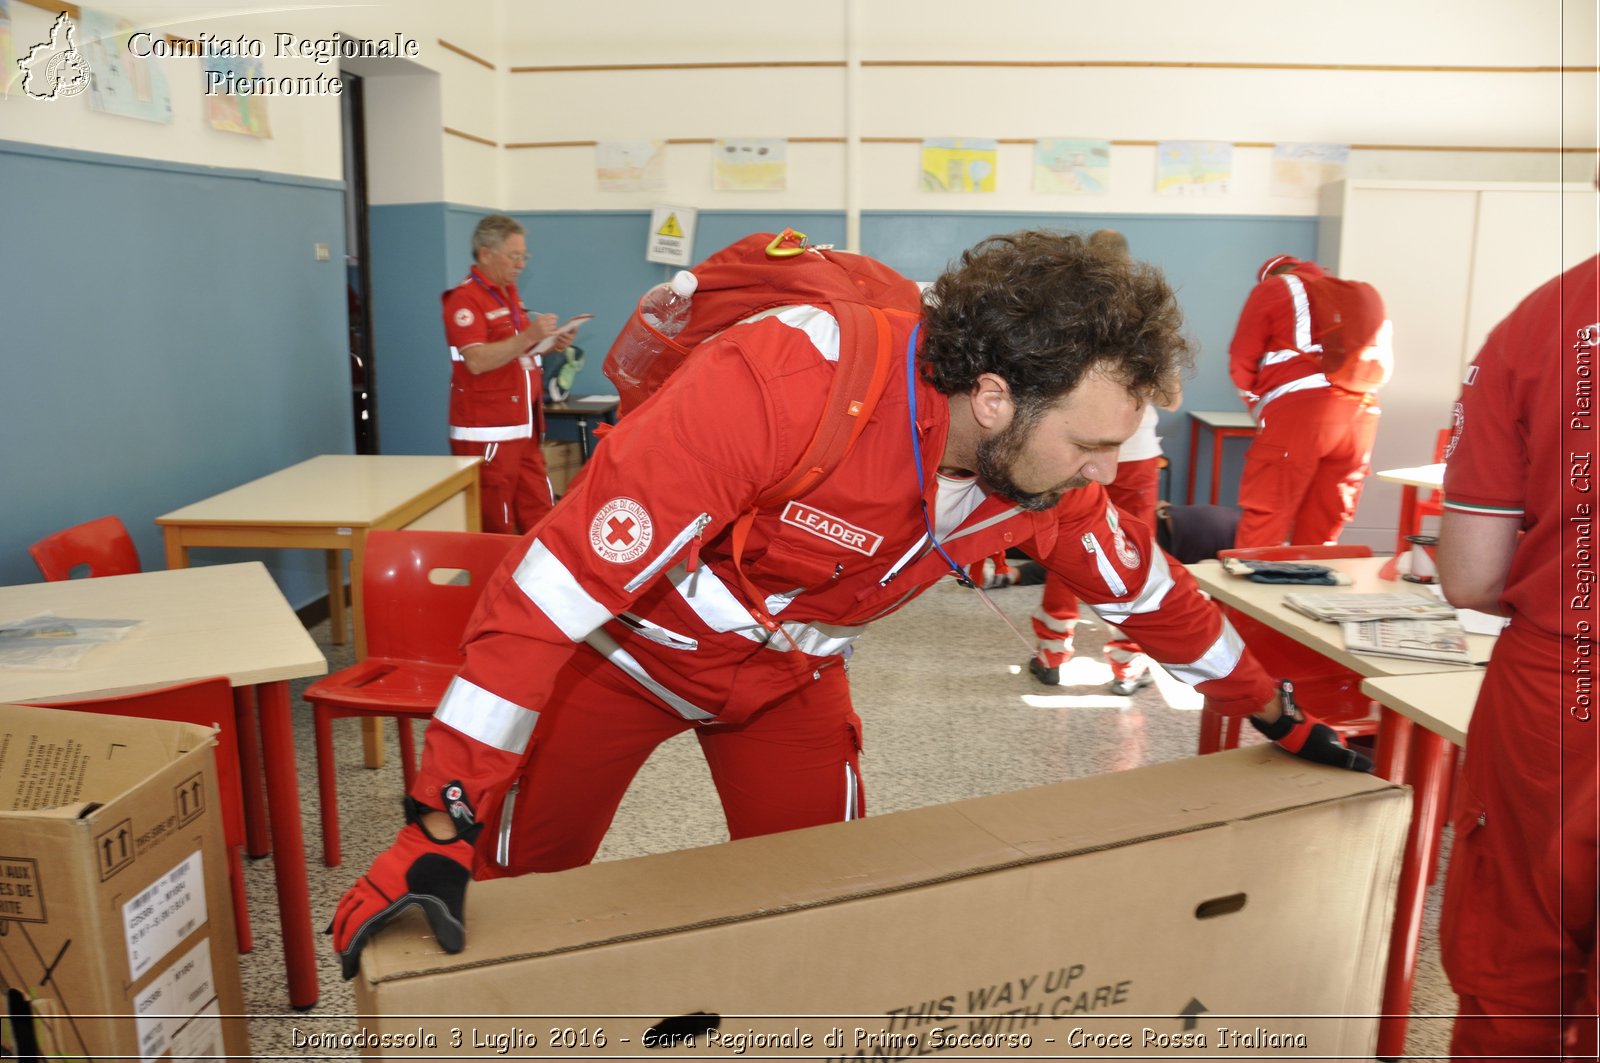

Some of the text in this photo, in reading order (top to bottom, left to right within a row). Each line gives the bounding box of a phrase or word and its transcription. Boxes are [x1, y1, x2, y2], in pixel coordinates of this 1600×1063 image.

[620, 500, 627, 509] DI
[628, 502, 651, 531] GINEVRA
[591, 501, 618, 546] CONVENZIONE
[641, 531, 651, 541] 22
[794, 509, 867, 548] LEADER
[621, 541, 647, 561] AGOSTO
[886, 963, 1086, 1035] THIS WAY UP
[968, 1003, 1044, 1038] WITH
[1051, 980, 1133, 1020] CARE
